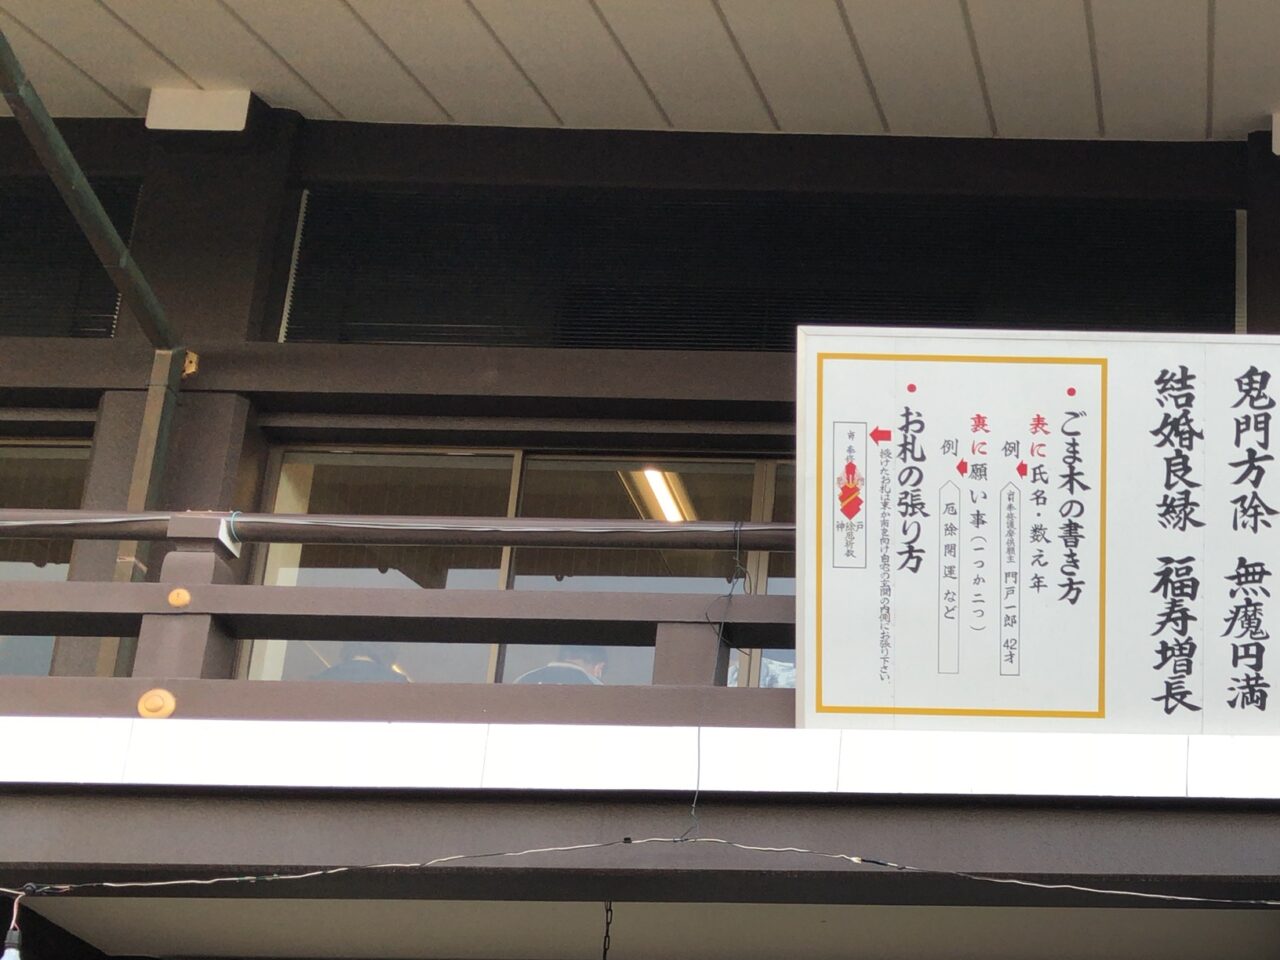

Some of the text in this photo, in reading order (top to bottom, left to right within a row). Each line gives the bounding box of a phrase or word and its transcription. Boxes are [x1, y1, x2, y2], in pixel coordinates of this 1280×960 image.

[897, 406, 930, 574] お札の張り方
[940, 439, 959, 457] 例
[1002, 439, 1020, 458] 例
[1029, 414, 1051, 593] 表に氏名・数え年
[1058, 410, 1091, 605] ごま木の書き方
[1221, 365, 1280, 710] 鬼門方除 無魔円満
[1150, 365, 1204, 715] 結婚良縁 福寿増長
